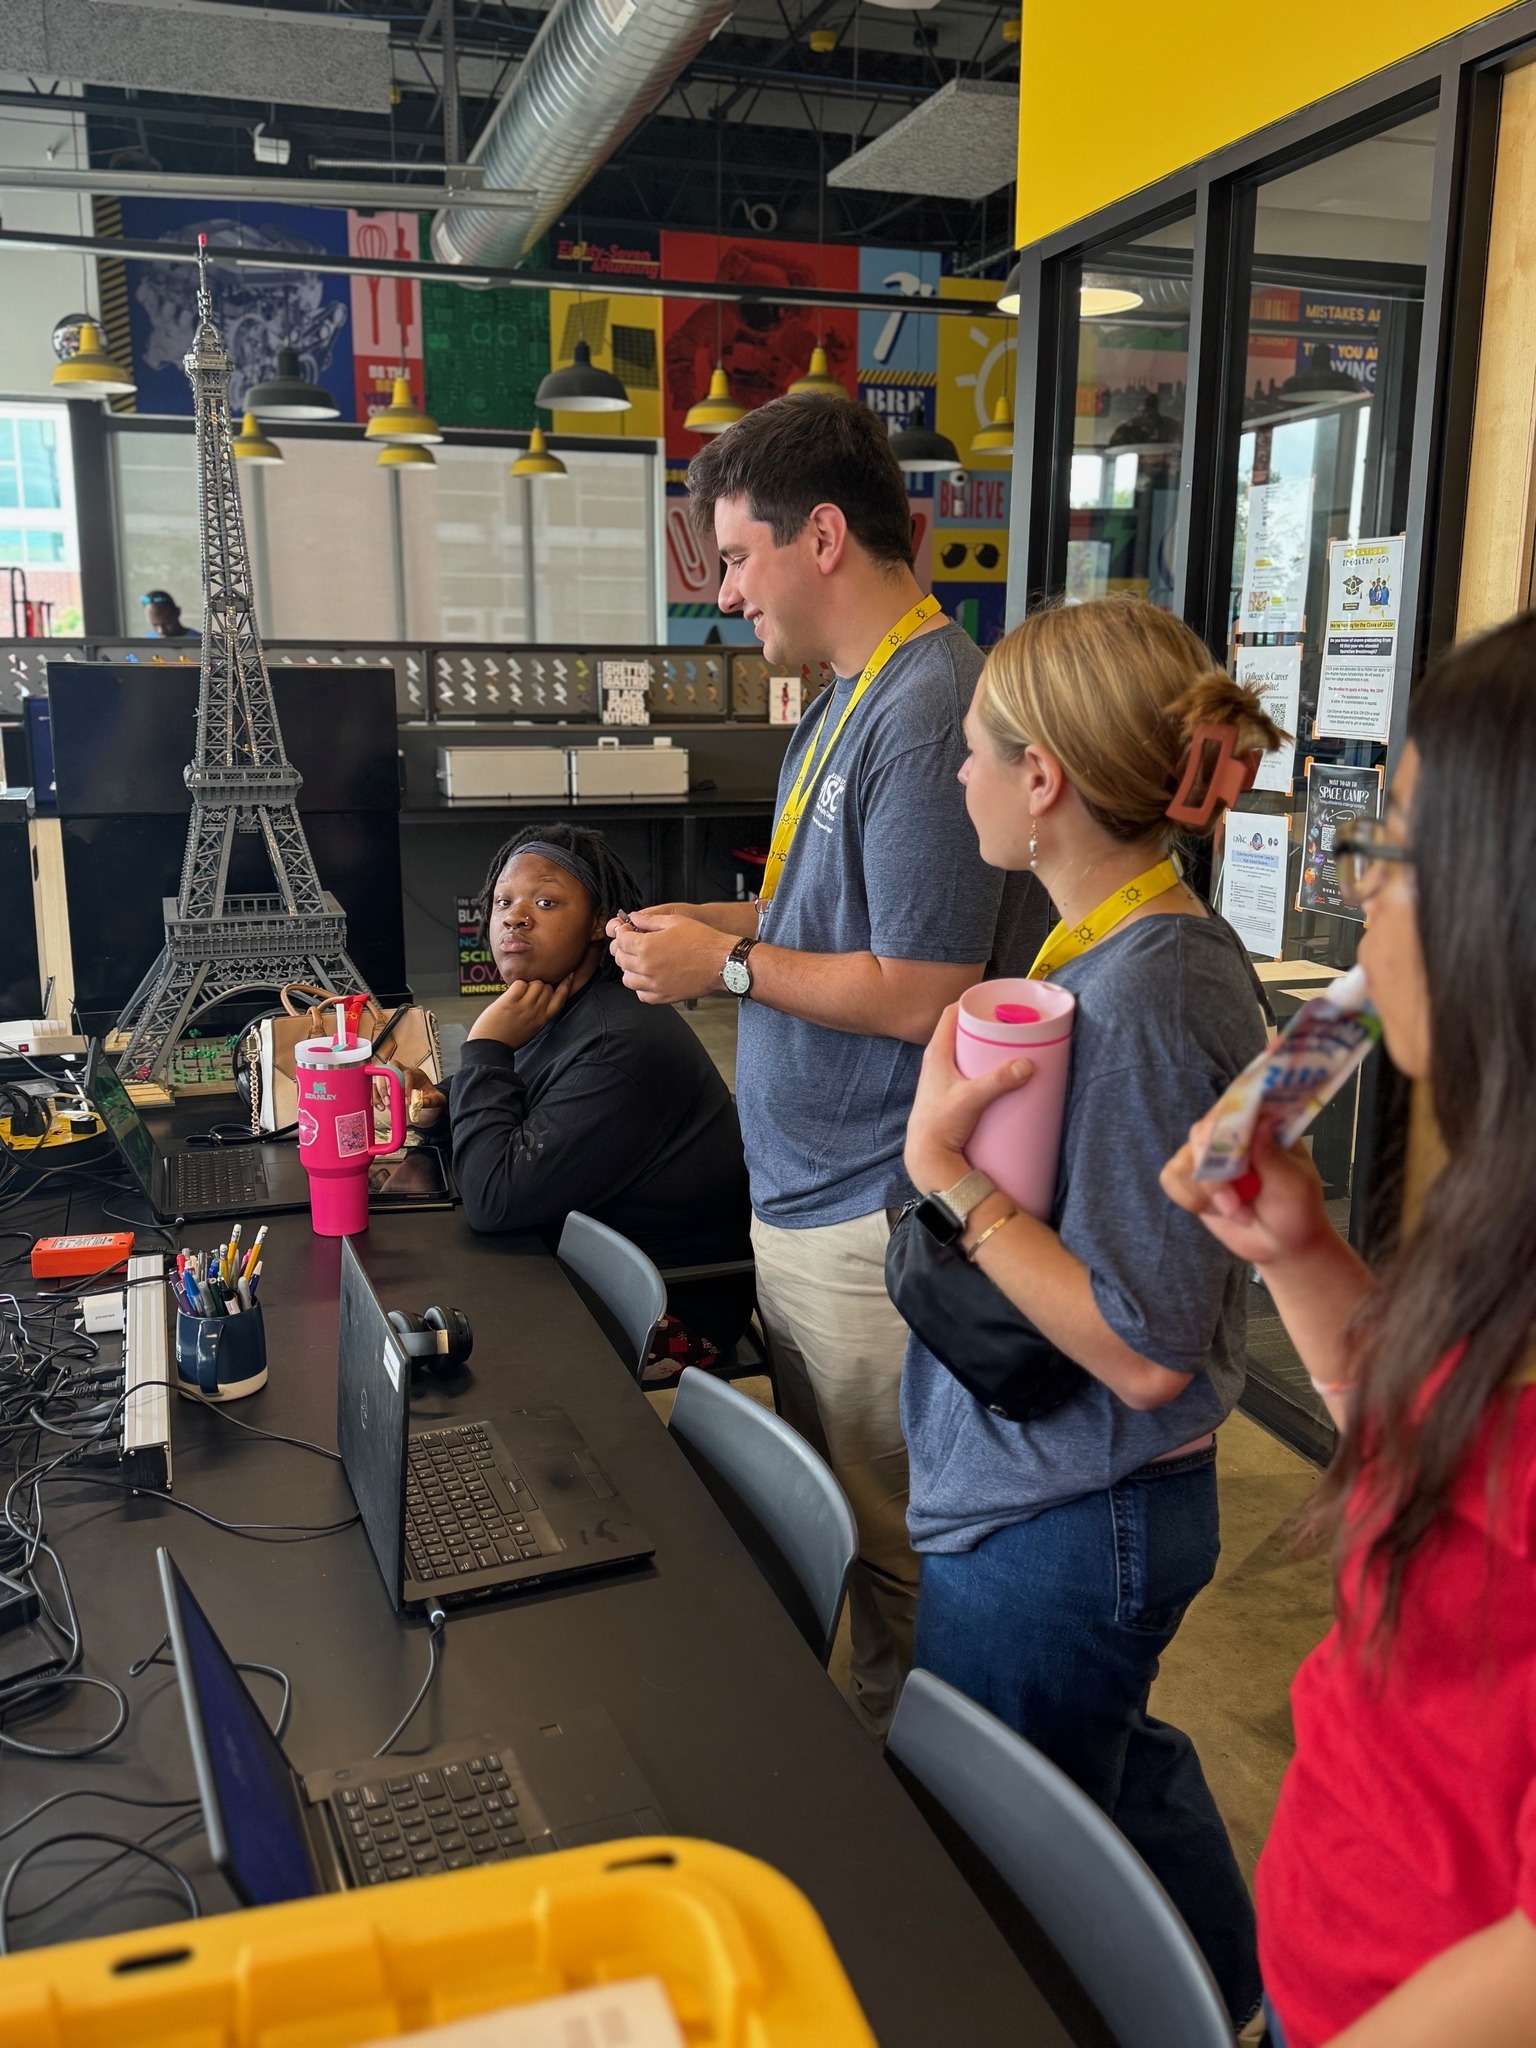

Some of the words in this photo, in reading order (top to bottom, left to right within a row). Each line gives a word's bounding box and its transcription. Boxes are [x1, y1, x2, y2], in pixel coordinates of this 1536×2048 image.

[1305, 304, 1365, 321] MISTAKES
[1337, 344, 1363, 360] YOU
[1271, 672, 1289, 681] Career
[1319, 785, 1341, 800] SPACE
[1343, 788, 1370, 803] CAMP?
[460, 964, 503, 983] LOV
[461, 984, 509, 993] KINDNES
